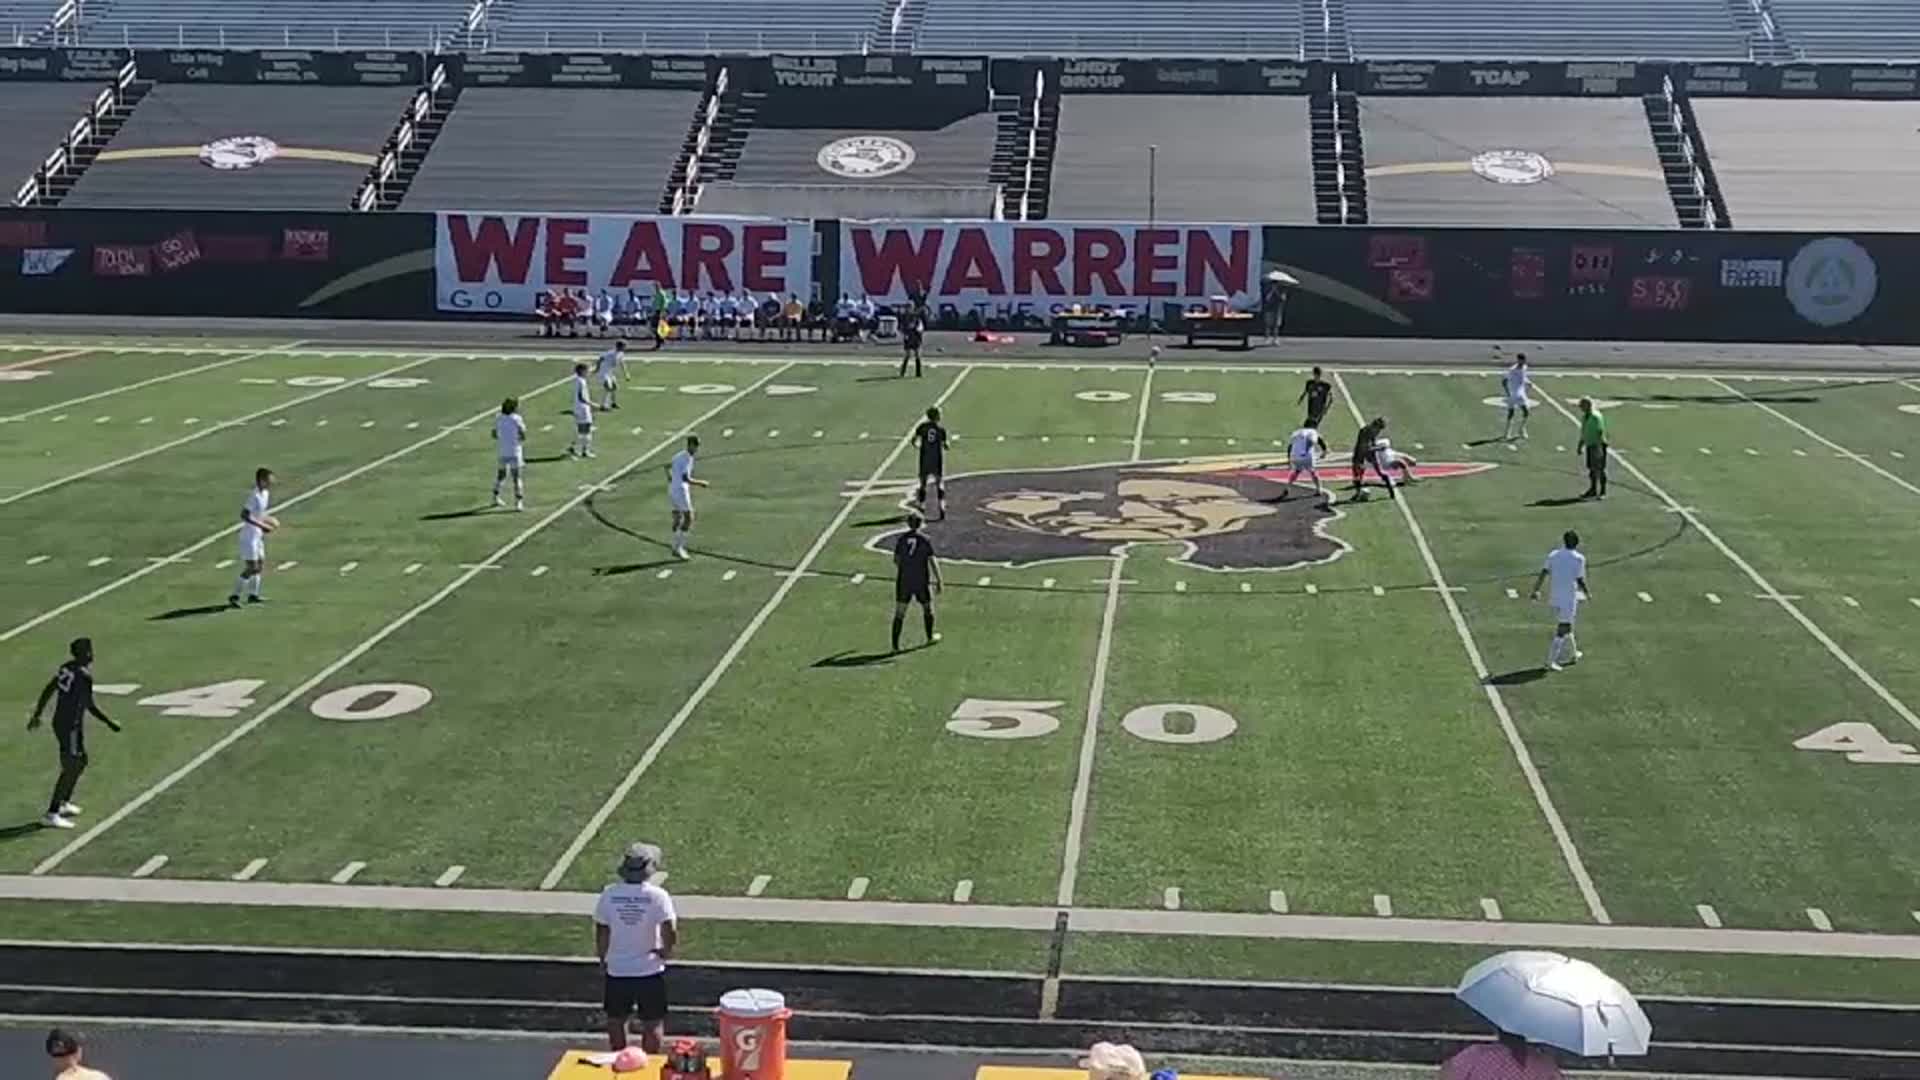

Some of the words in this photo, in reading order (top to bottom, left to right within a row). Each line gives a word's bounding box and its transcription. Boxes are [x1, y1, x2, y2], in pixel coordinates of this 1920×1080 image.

[1060, 74, 1124, 88] GROUP
[1470, 70, 1528, 85] TCAP
[447, 213, 589, 286] WE
[609, 221, 787, 292] ARE
[851, 228, 1250, 297] WARREN
[450, 289, 503, 309] GO
[927, 428, 937, 443] 6
[907, 538, 917, 556] 7
[945, 698, 1238, 744] 50
[736, 1028, 757, 1051] G
